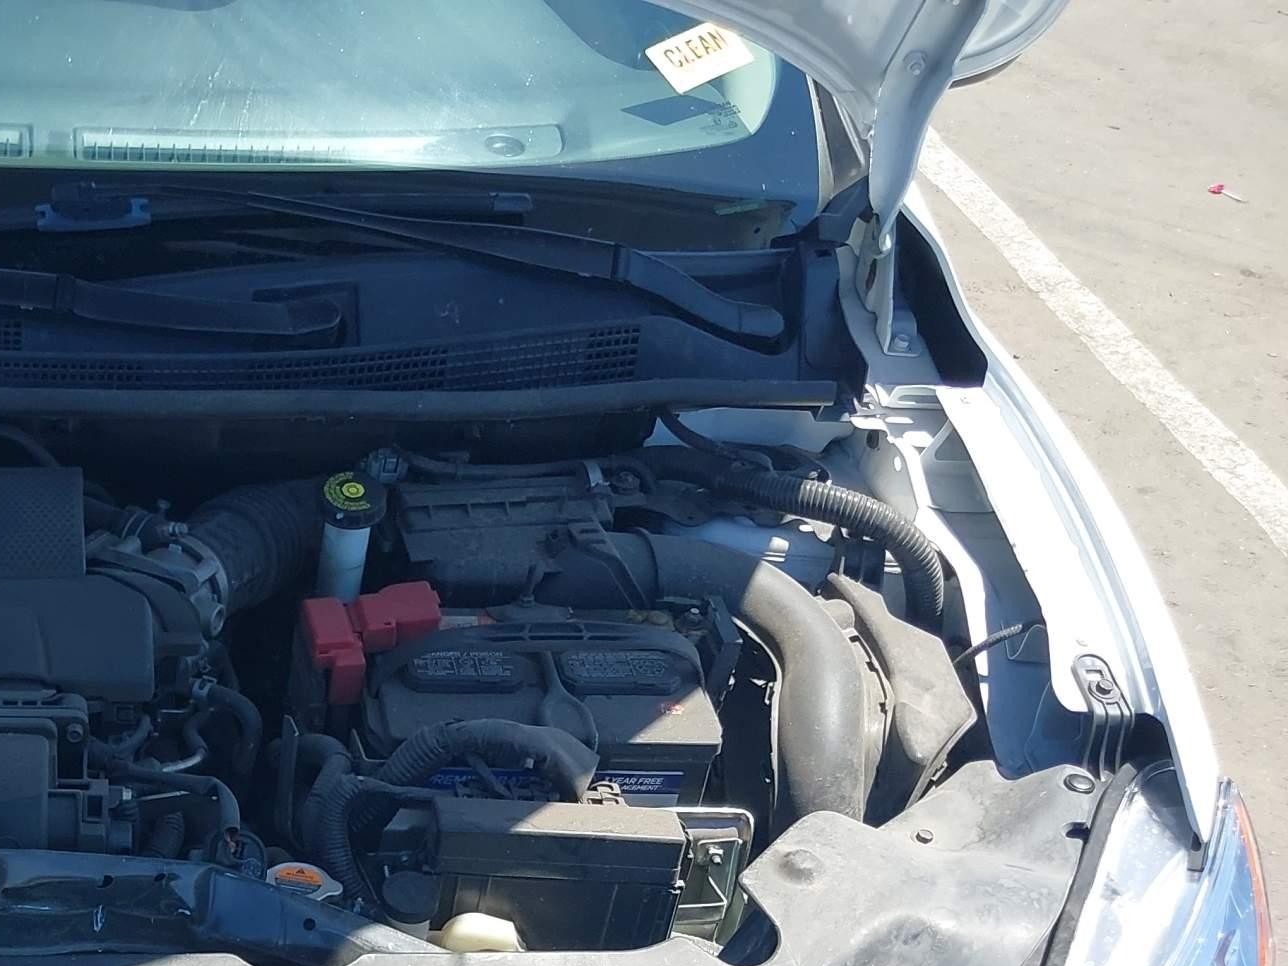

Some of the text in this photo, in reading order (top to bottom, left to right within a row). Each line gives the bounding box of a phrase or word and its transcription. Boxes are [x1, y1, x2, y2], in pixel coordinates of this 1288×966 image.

[663, 30, 728, 67] CLEAN
[612, 777, 636, 785] YEAR
[636, 777, 664, 785] FREE
